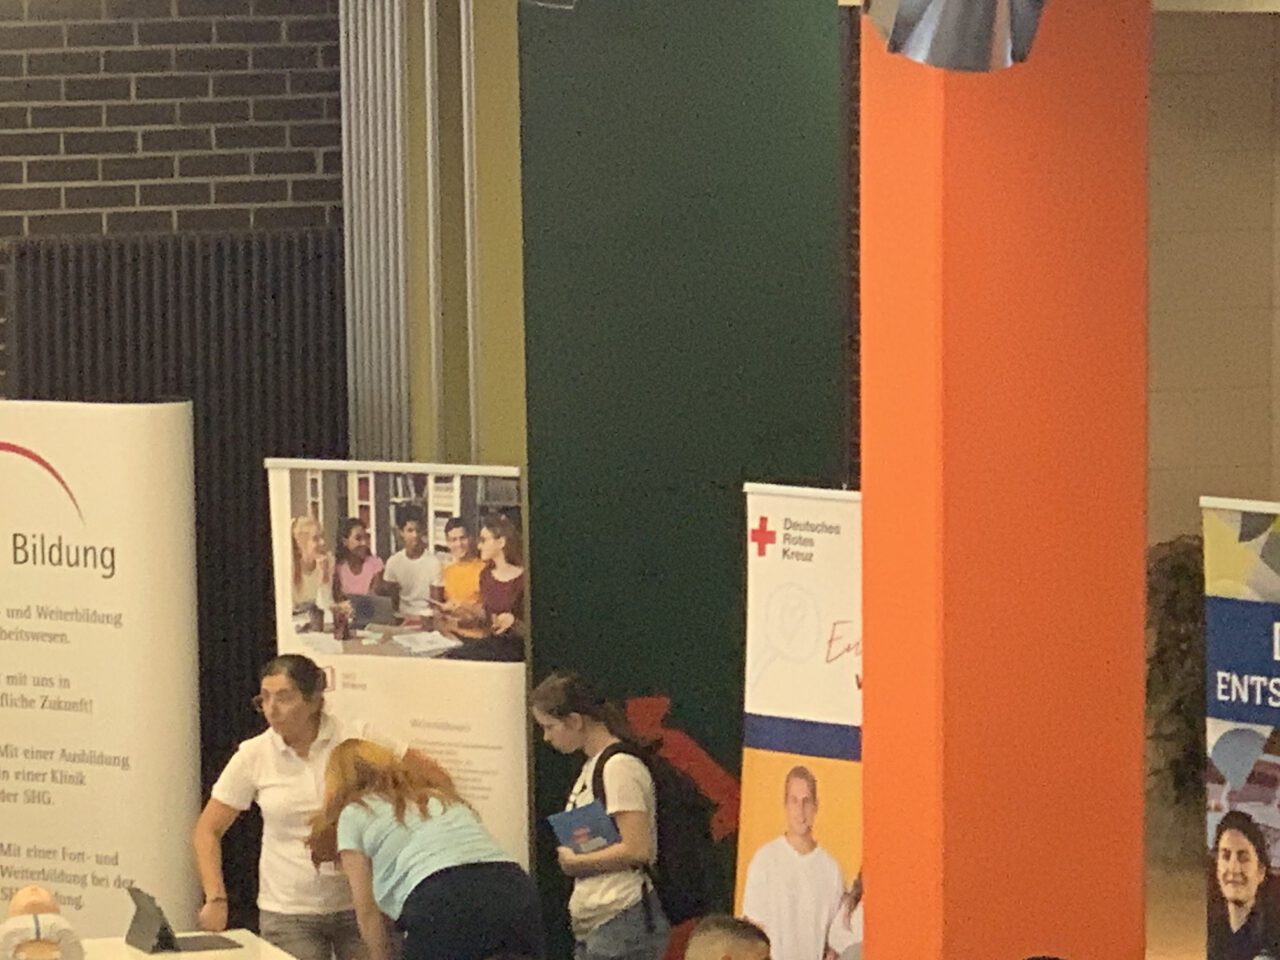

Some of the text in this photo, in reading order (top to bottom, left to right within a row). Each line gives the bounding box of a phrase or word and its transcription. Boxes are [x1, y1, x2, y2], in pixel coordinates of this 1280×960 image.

[783, 518, 841, 535] Deutsches
[782, 533, 815, 547] Rotes
[12, 532, 116, 579] Bildung
[782, 549, 814, 562] Kreuz
[6, 605, 31, 620] und
[36, 604, 124, 629] Weiterbildung
[6, 672, 29, 687] mit
[32, 674, 54, 688] uns
[58, 675, 71, 689] in
[22, 746, 56, 761] einer
[59, 748, 130, 771] Ausbildung
[14, 767, 48, 783] einer
[50, 768, 87, 786] Klinik
[0, 842, 21, 857] Mit
[25, 845, 58, 860] einer
[95, 851, 119, 866] und
[0, 864, 88, 888] Weiterbildung
[91, 872, 110, 888] bei
